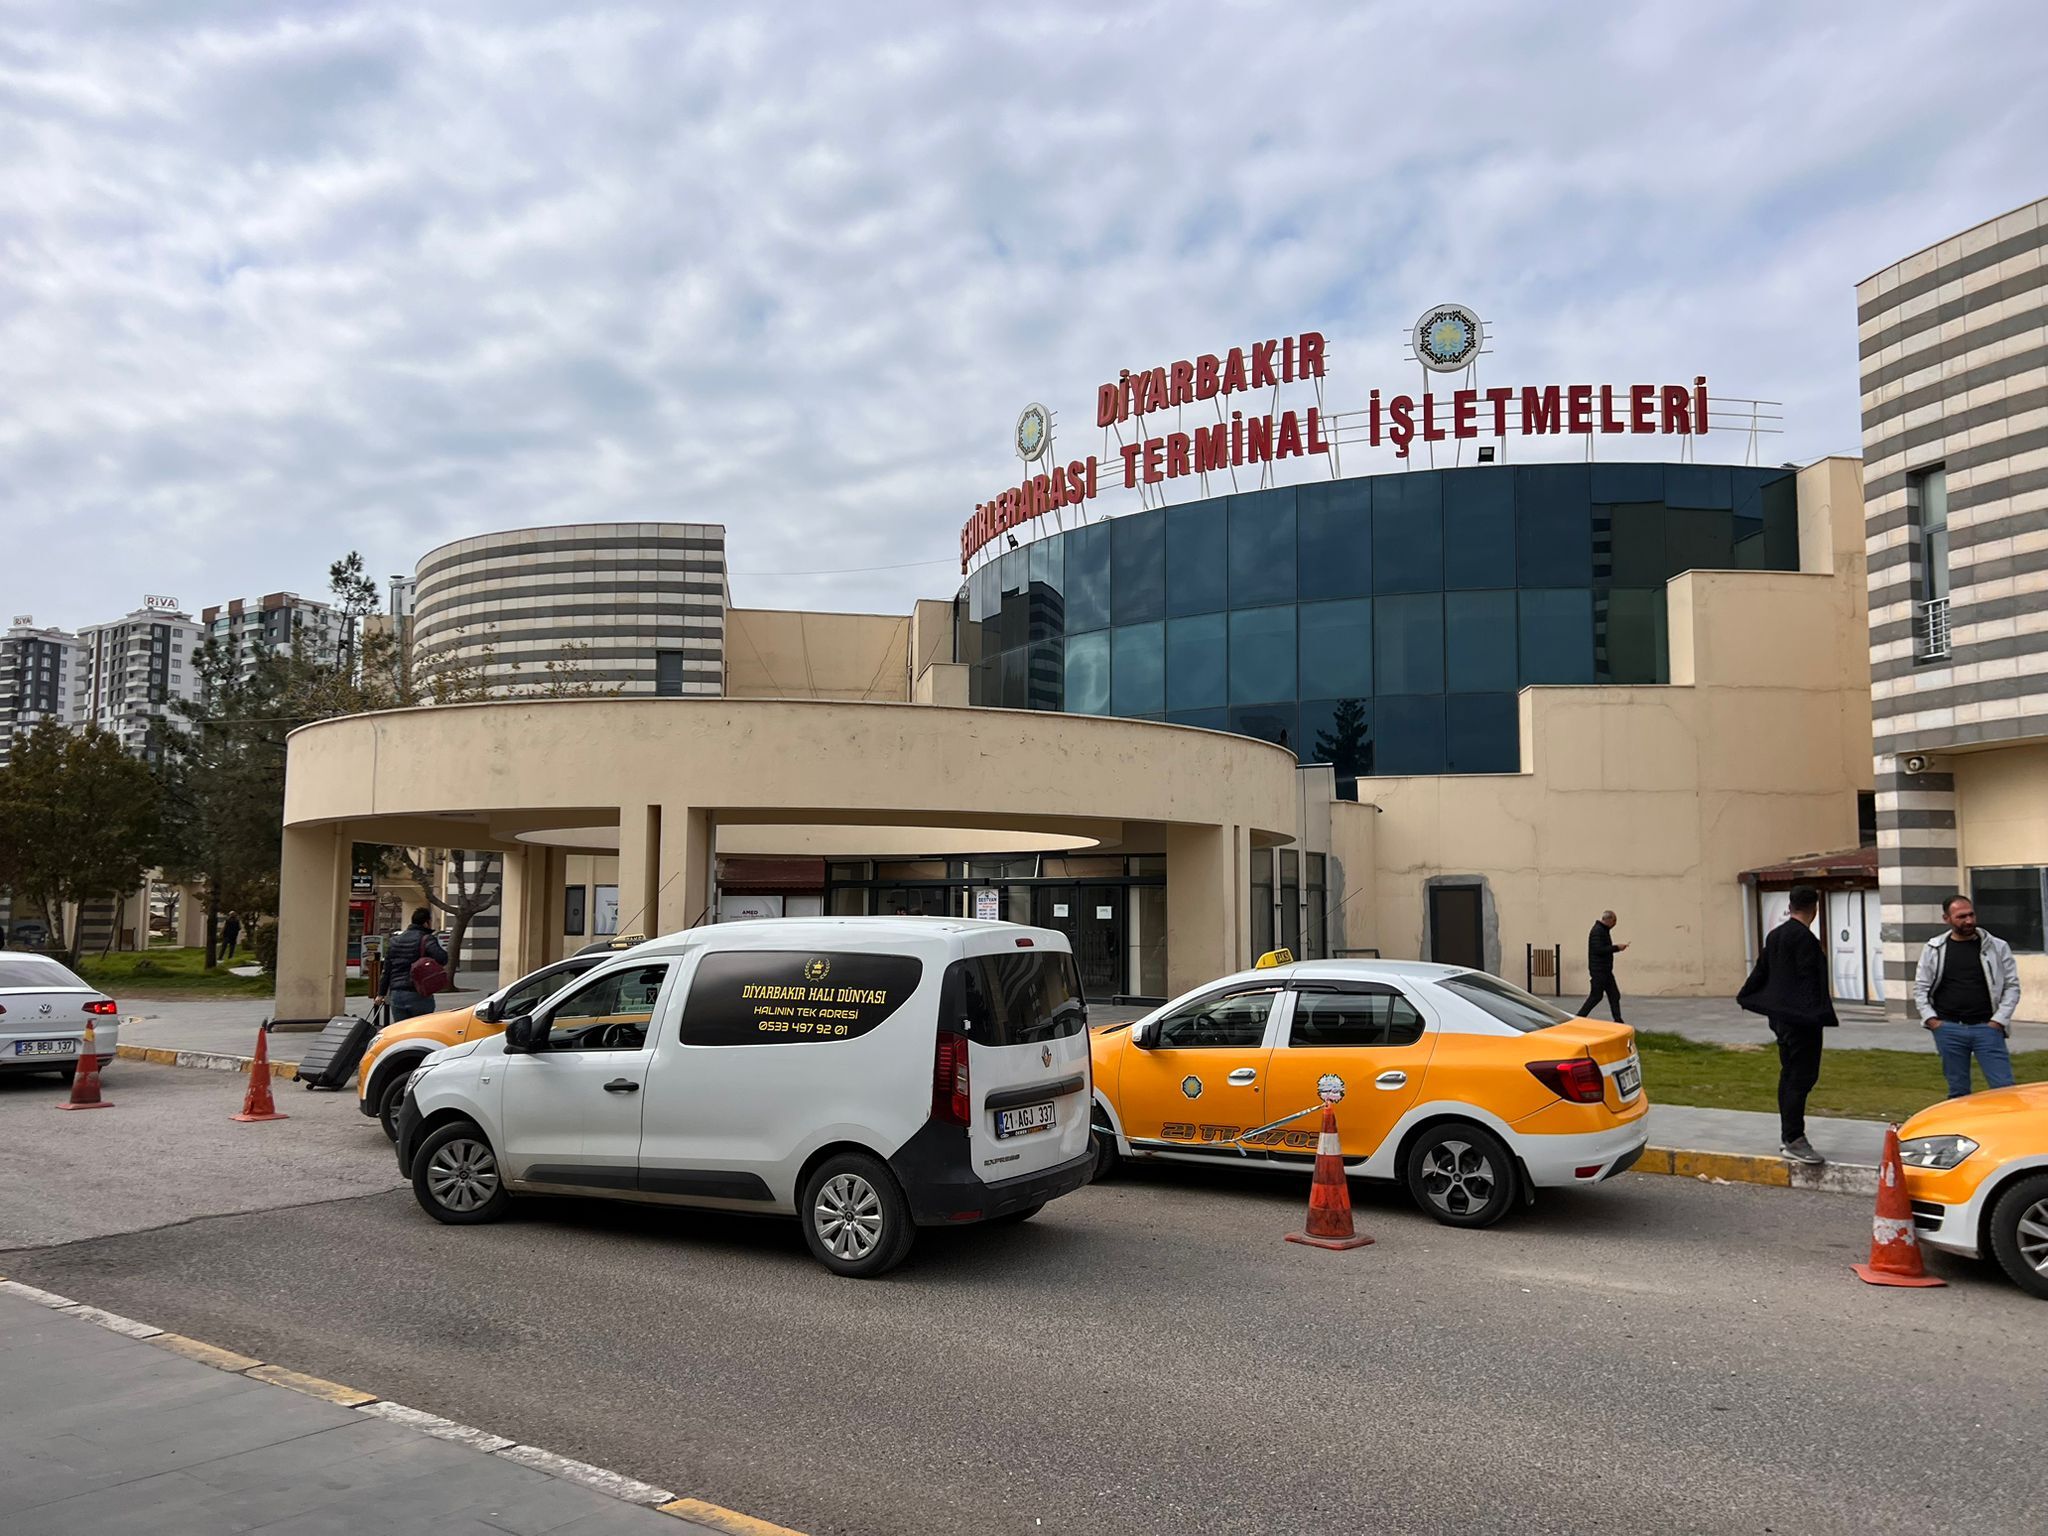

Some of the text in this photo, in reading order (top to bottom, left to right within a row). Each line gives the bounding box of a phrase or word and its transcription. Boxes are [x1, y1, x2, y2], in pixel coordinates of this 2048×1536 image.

[1097, 331, 1326, 428] DİYARBAKIR
[1119, 406, 1329, 489] TERMİNAL
[1369, 375, 1709, 459] İŞLETMELERİ
[742, 983, 887, 1004] DİYARBAKIR HALI DÜNYASI
[753, 1006, 859, 1020] HALININ TEK ADRESİ
[758, 1021, 849, 1036] 0533 497 92 01
[22, 1042, 33, 1052] 35
[58, 1041, 72, 1050] 137
[1003, 1112, 1014, 1130] 21
[1018, 1108, 1034, 1128] AGJ
[1039, 1104, 1053, 1123] 337
[1161, 1122, 1196, 1140] 21
[1199, 1124, 1241, 1141] TT
[984, 1153, 1020, 1166] EXPRESS
